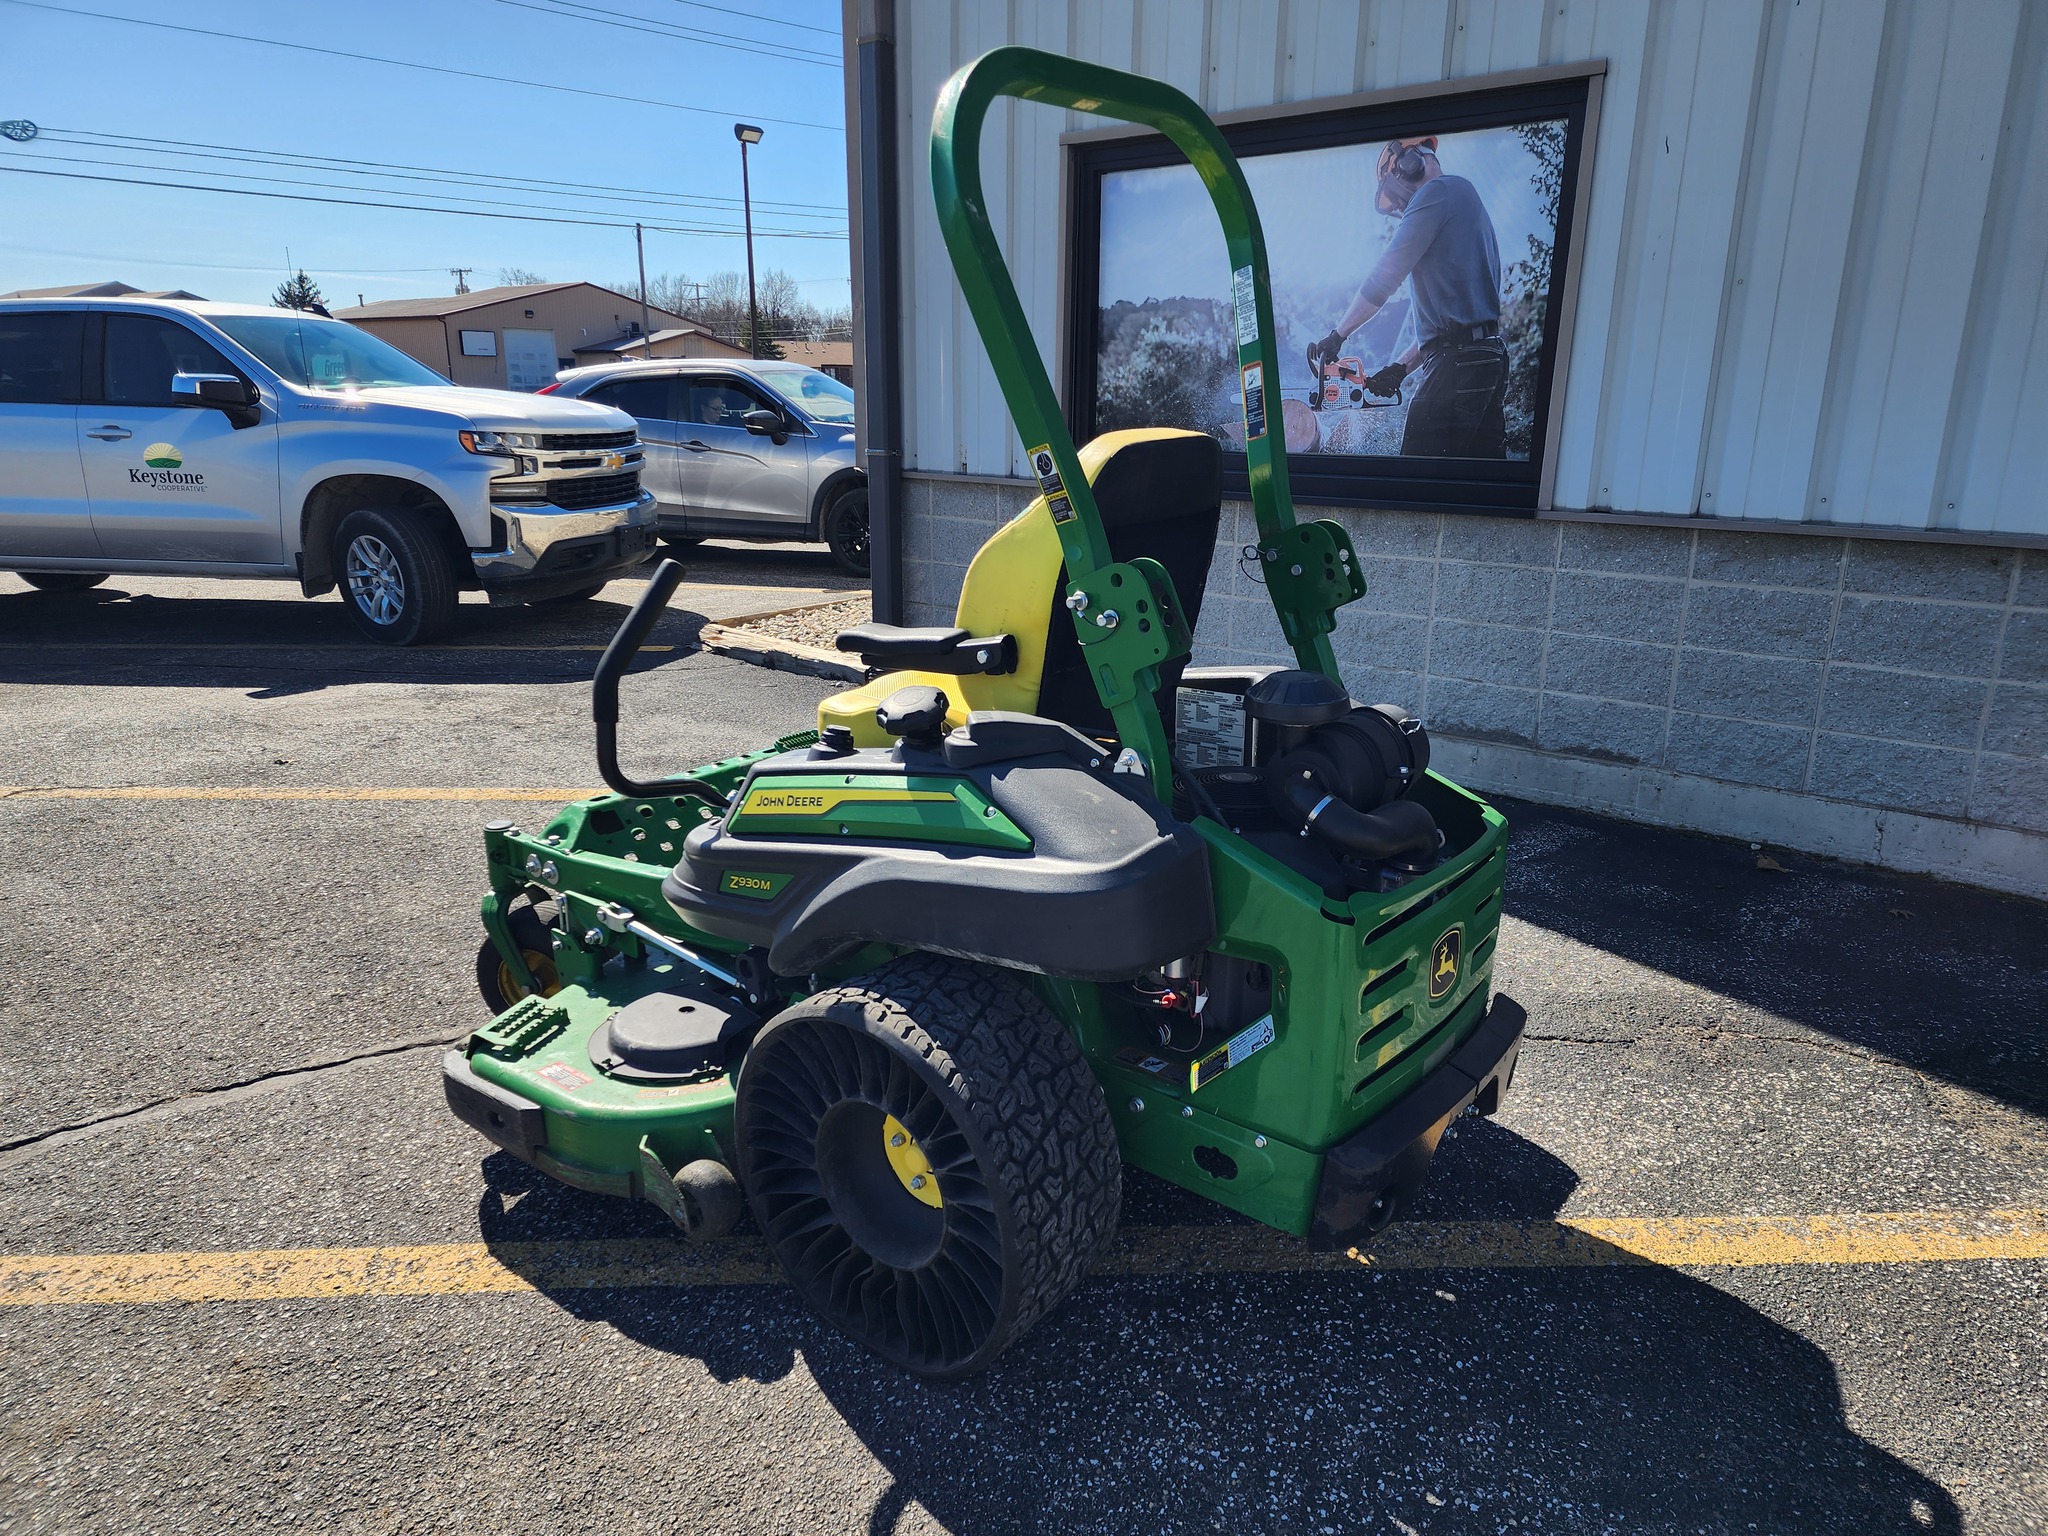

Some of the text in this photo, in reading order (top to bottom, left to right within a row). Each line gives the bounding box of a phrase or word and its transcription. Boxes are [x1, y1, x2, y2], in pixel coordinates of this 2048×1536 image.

[128, 468, 204, 488] Keystone
[157, 484, 206, 493] COOPERATIVE
[756, 795, 824, 807] JOHN DEERE
[729, 875, 771, 891] Z930M
